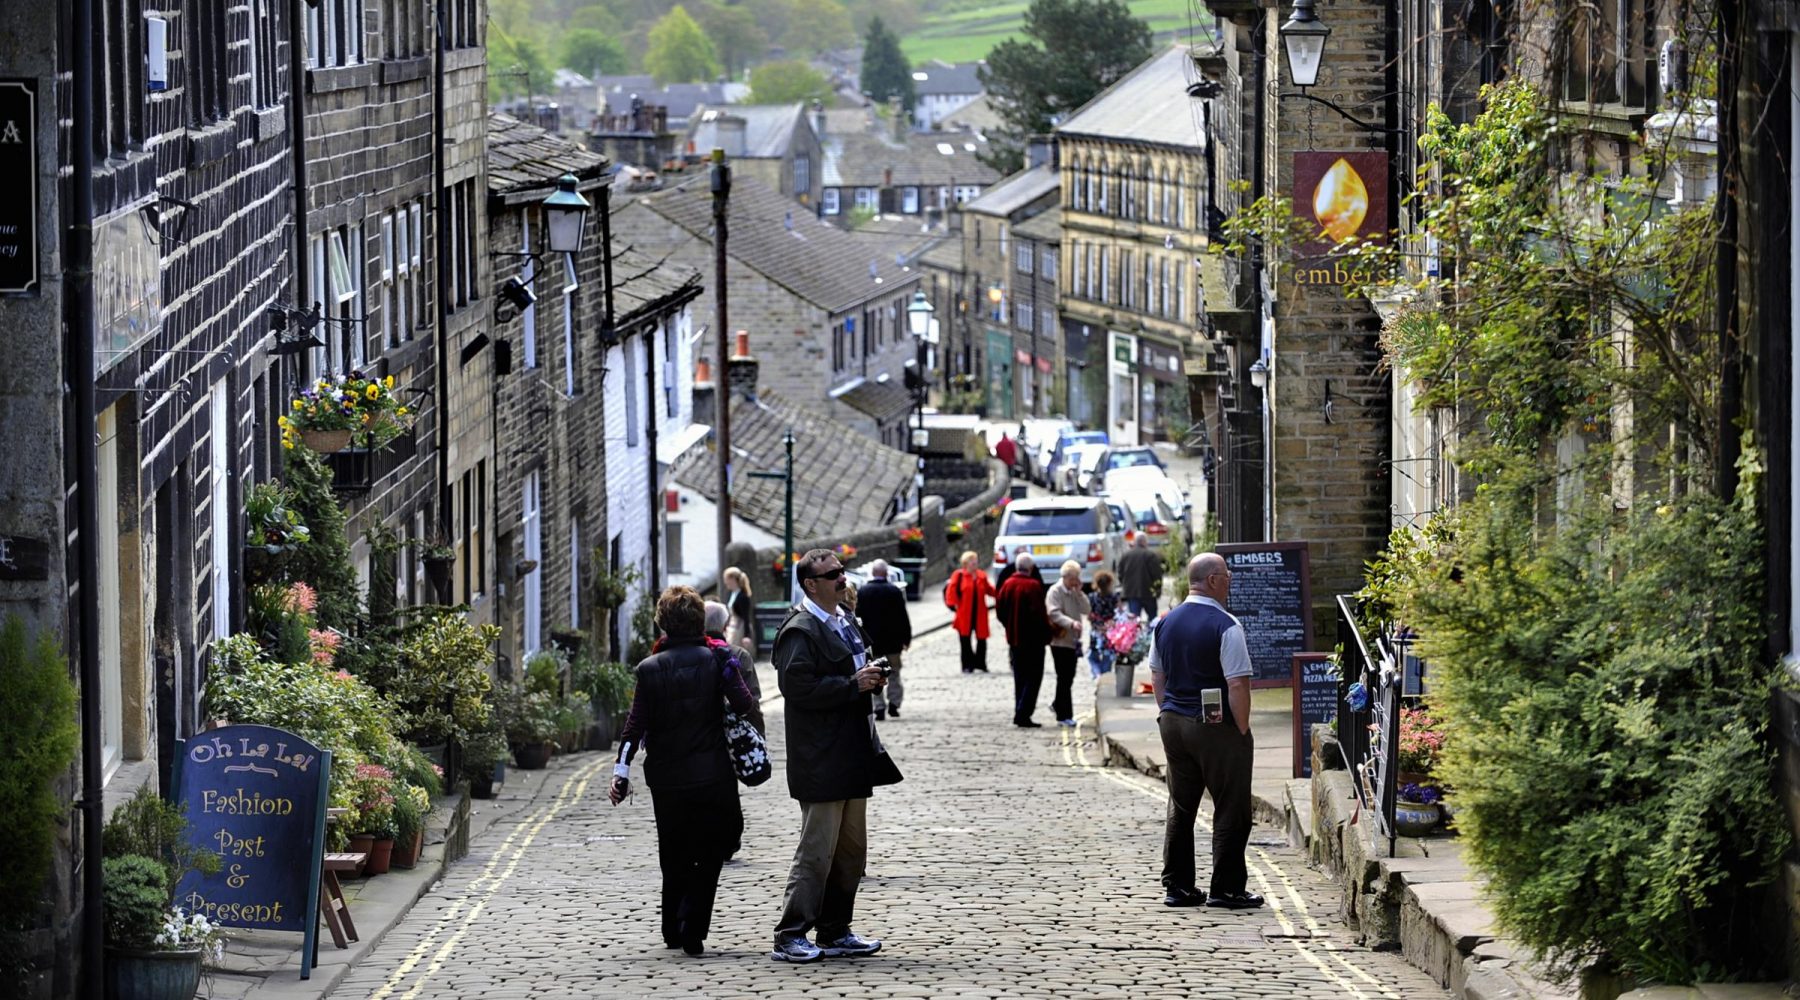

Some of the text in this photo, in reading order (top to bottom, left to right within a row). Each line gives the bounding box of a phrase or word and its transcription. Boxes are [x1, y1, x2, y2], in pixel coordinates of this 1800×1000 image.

[1233, 551, 1283, 564] EMBERS
[1303, 674, 1323, 683] PIZZA
[191, 737, 314, 771] Oh La La!
[202, 788, 293, 816] Fashion
[214, 828, 266, 857] Past
[226, 863, 250, 888] &
[185, 891, 283, 922] Present
